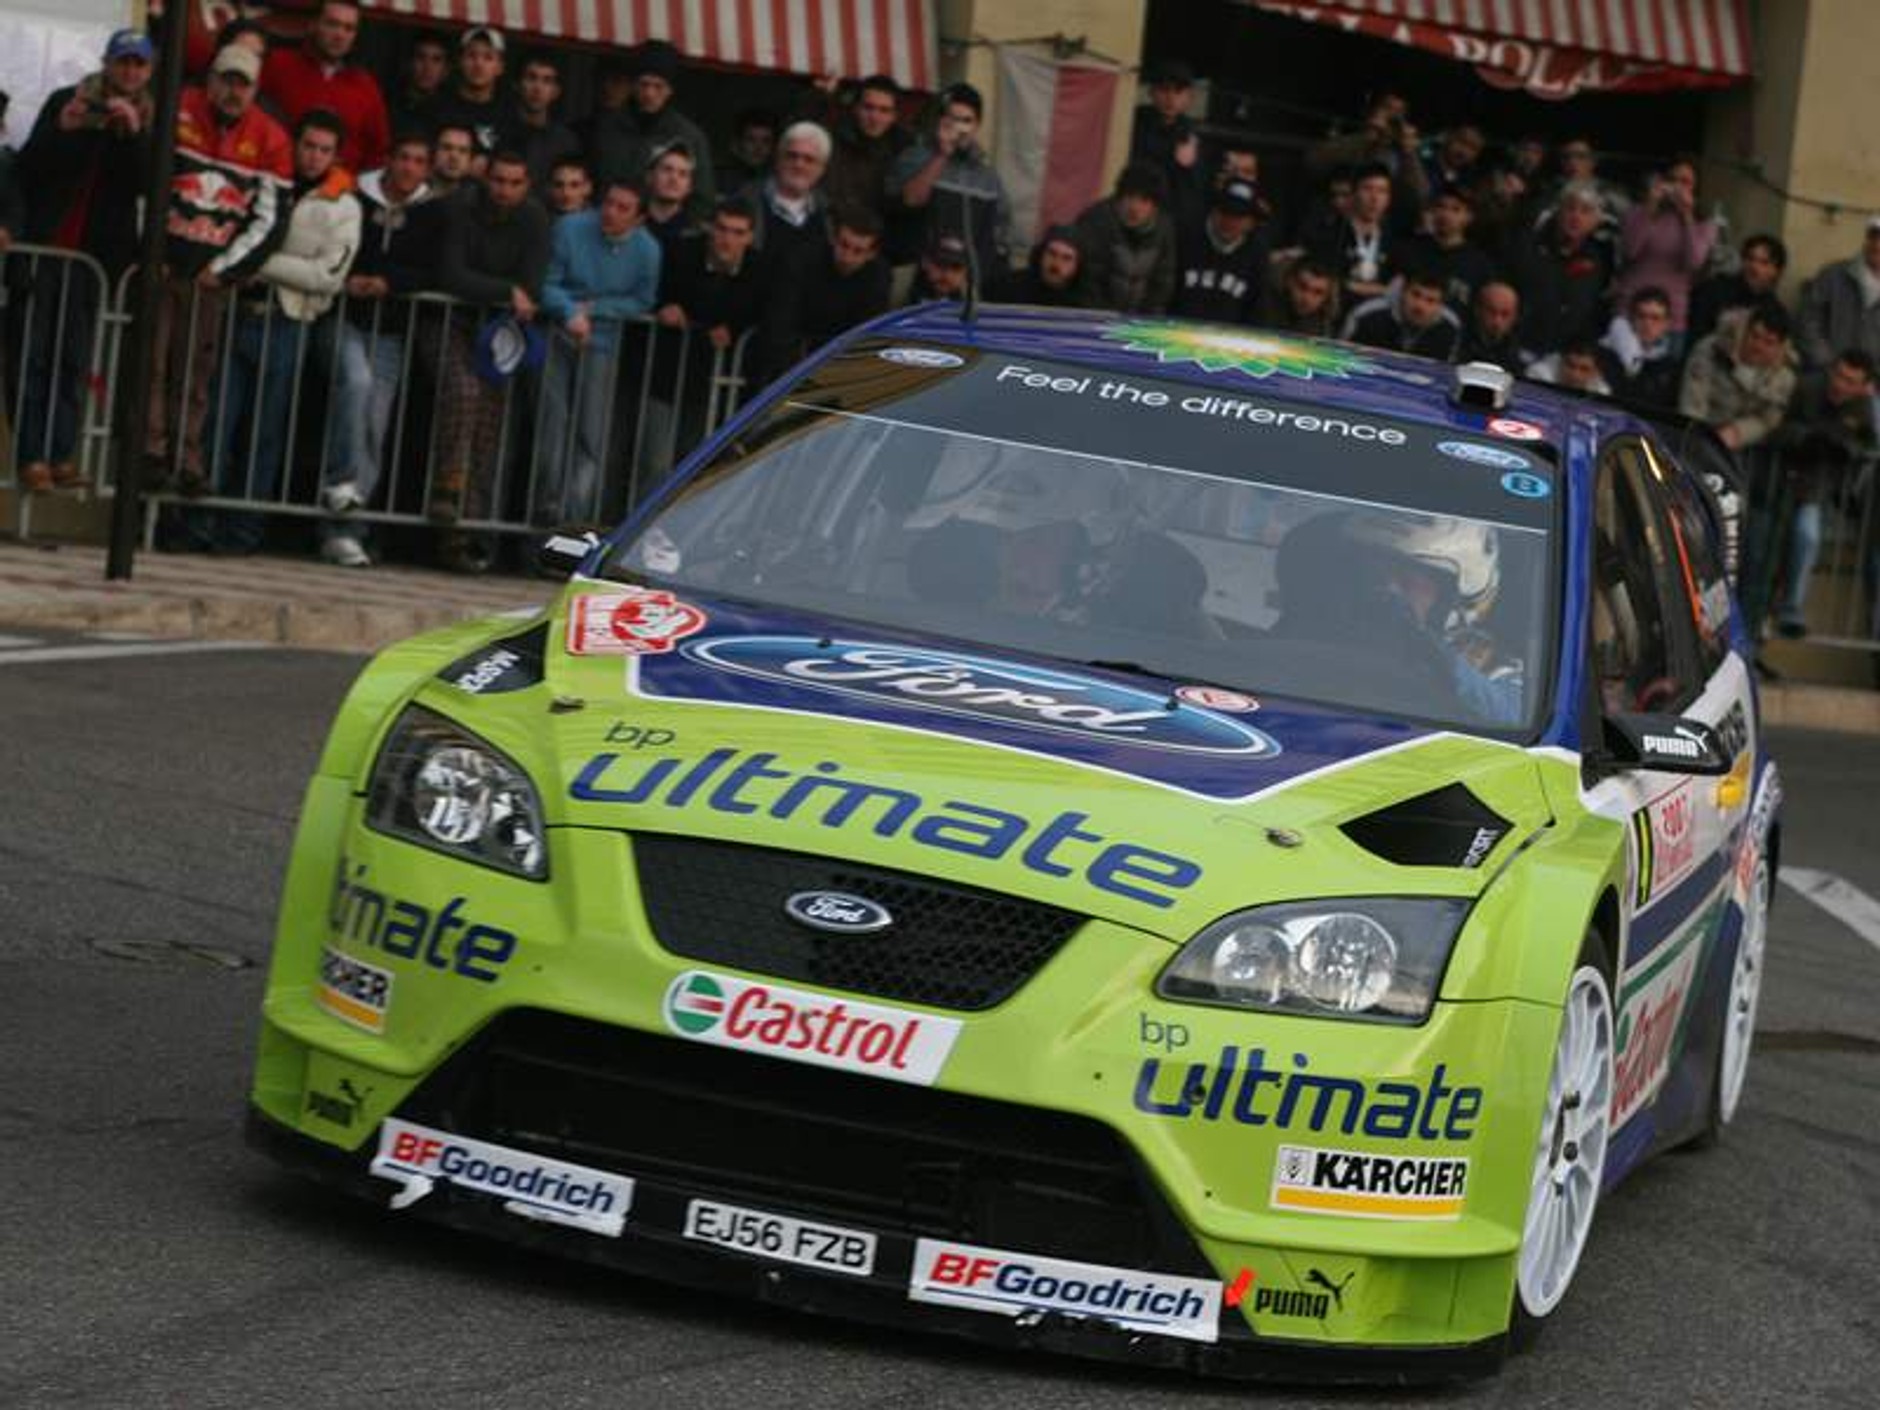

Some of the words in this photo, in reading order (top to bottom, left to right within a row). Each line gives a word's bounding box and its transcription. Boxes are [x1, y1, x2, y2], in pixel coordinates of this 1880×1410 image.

[996, 365, 1091, 394] Feel
[1099, 380, 1169, 407] the
[1181, 396, 1407, 446] difference
[783, 648, 1174, 733] Ford
[604, 721, 677, 750] bp
[1642, 734, 1698, 758] PUMA
[568, 747, 1204, 909] ultimate
[806, 897, 868, 923] Ford
[726, 986, 919, 1070] Castrol
[1139, 1012, 1189, 1053] bp
[1132, 1045, 1483, 1142] ultimate
[391, 1131, 616, 1215] BFGoodrich
[1313, 1152, 1467, 1197] KÄRCHER
[693, 1210, 784, 1252] EJ56
[794, 1230, 868, 1268] FZB
[928, 1252, 1205, 1320] BFGoodrich
[1254, 1287, 1329, 1320] PUMA
